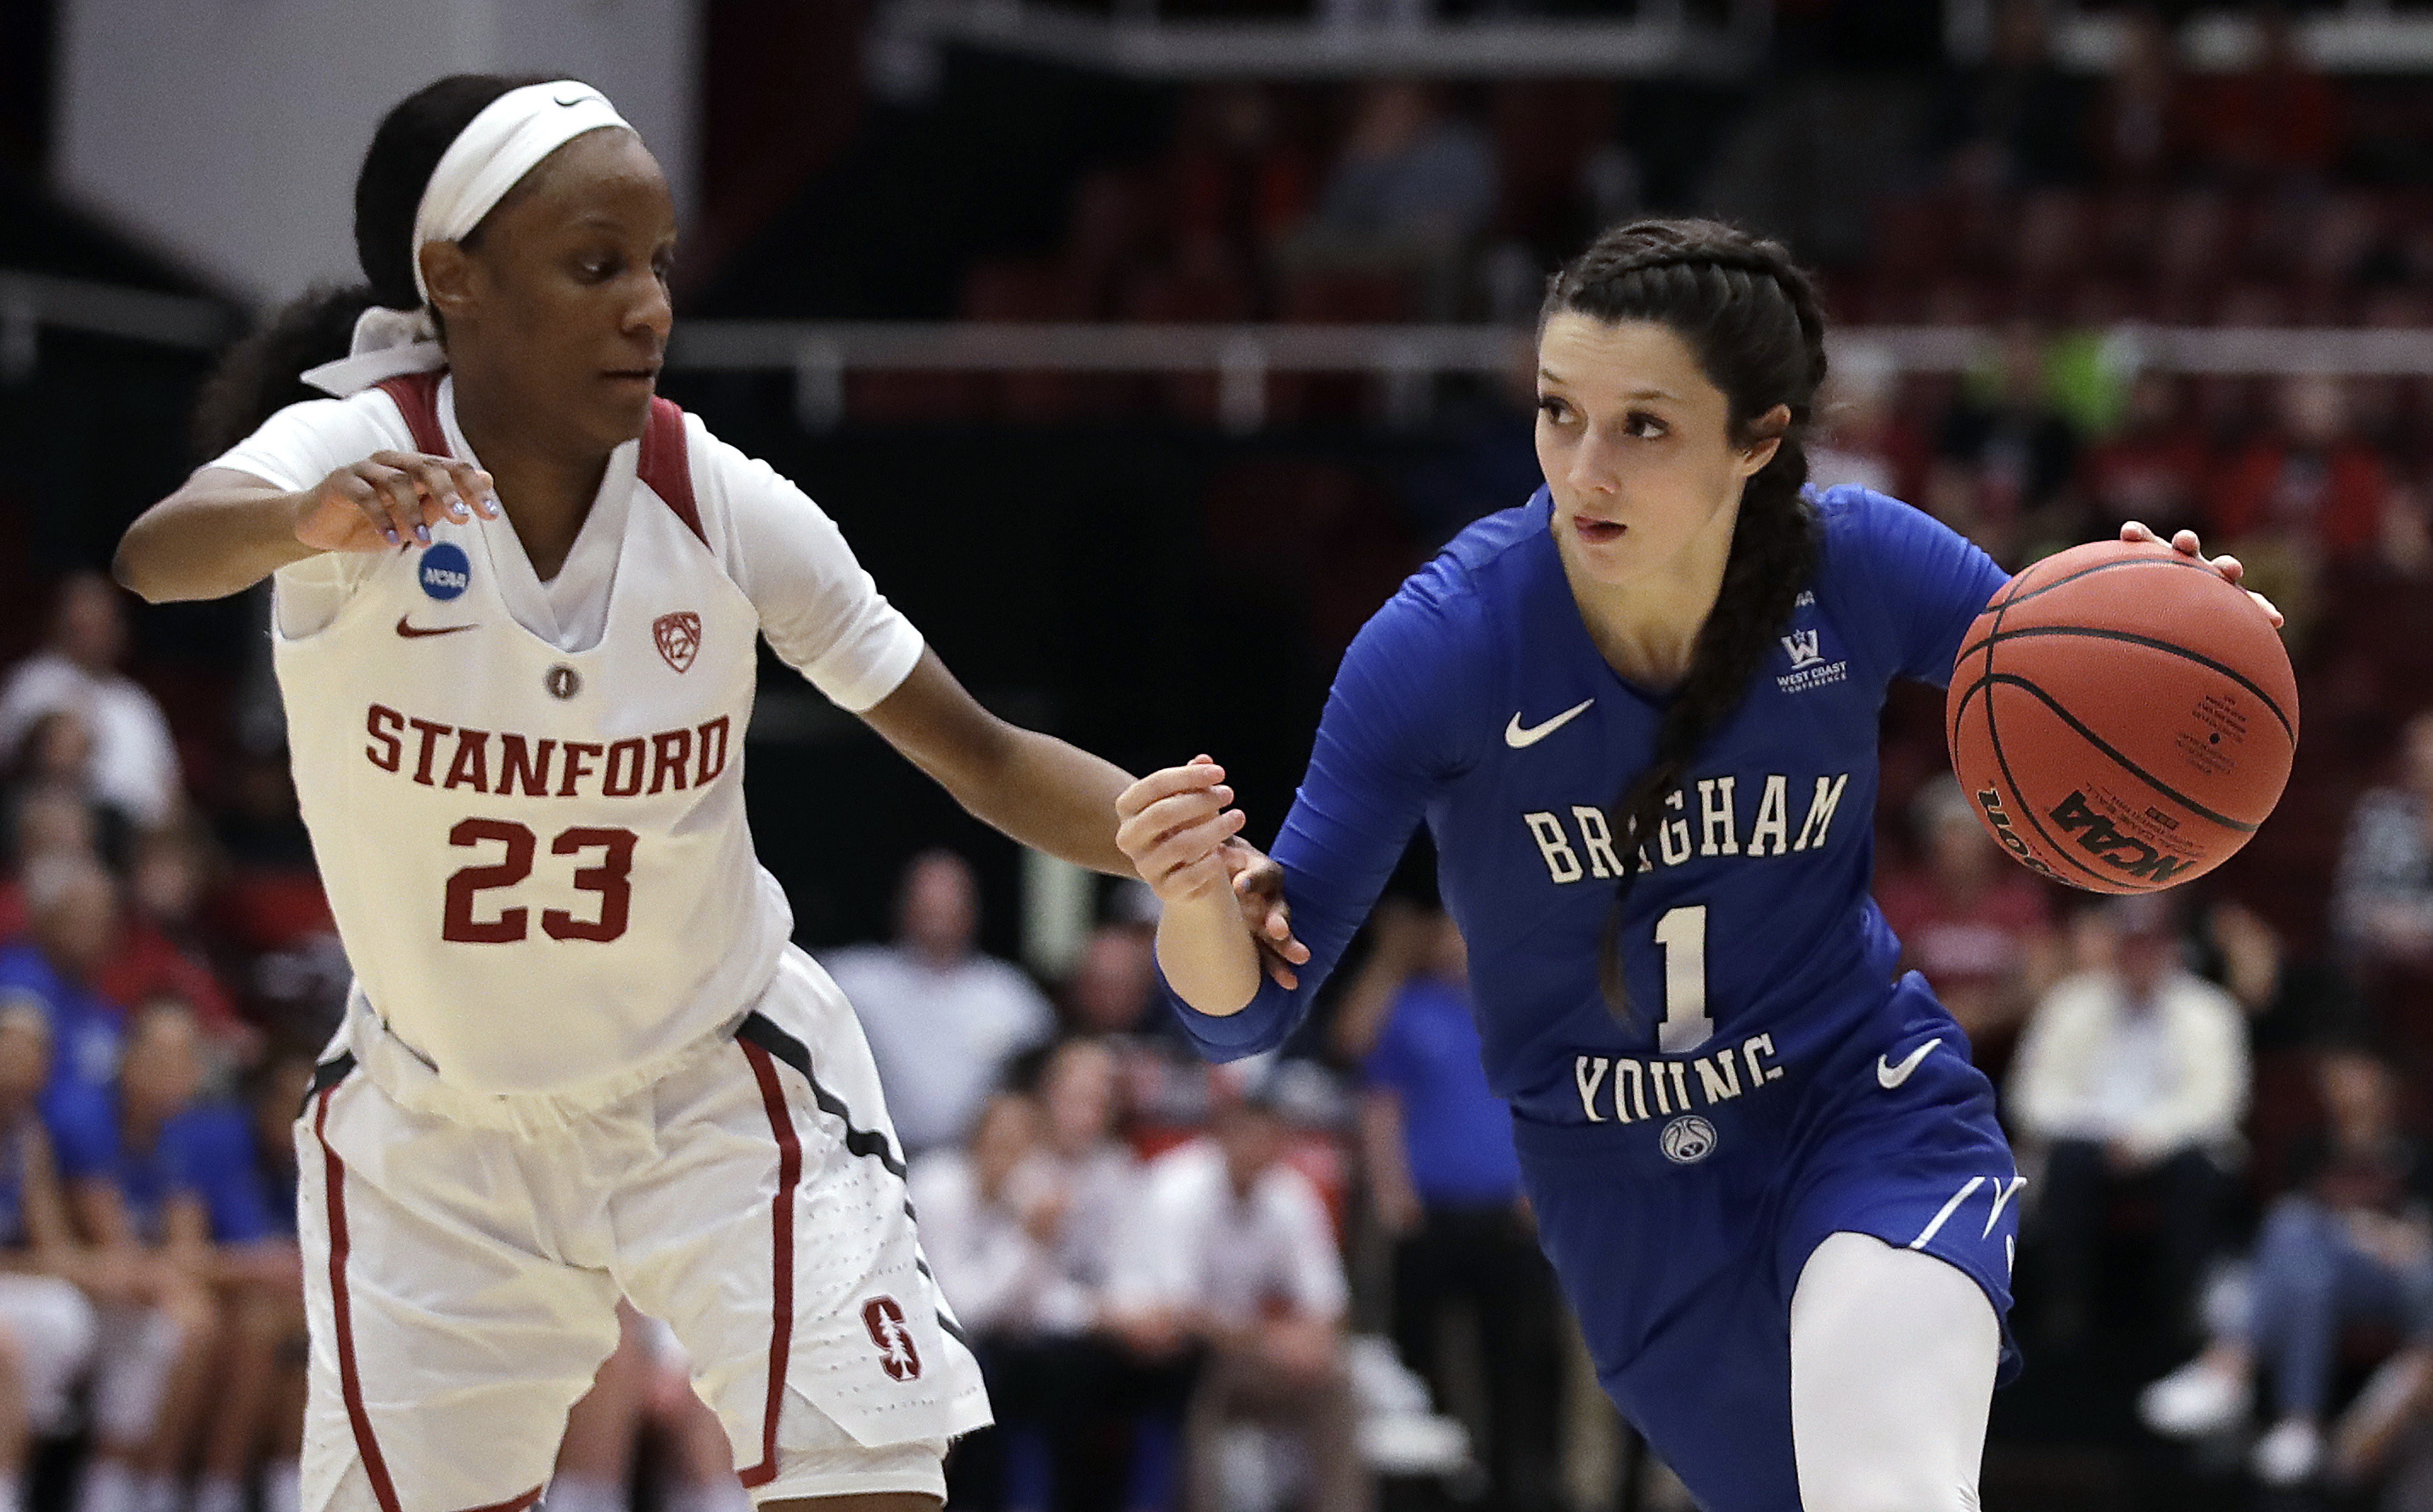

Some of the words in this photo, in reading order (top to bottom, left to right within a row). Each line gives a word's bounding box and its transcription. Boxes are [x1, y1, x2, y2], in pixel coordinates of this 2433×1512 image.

[425, 566, 466, 587] NCAA
[1794, 590, 1816, 608] AA
[1777, 670, 1810, 687] WEST
[1811, 660, 1847, 678] COAST
[1781, 672, 1847, 694] CONFERENCE
[366, 702, 731, 797] STANFORD
[2049, 790, 2197, 881] NCAA
[441, 816, 639, 944] 23
[1655, 904, 1715, 1054] 1
